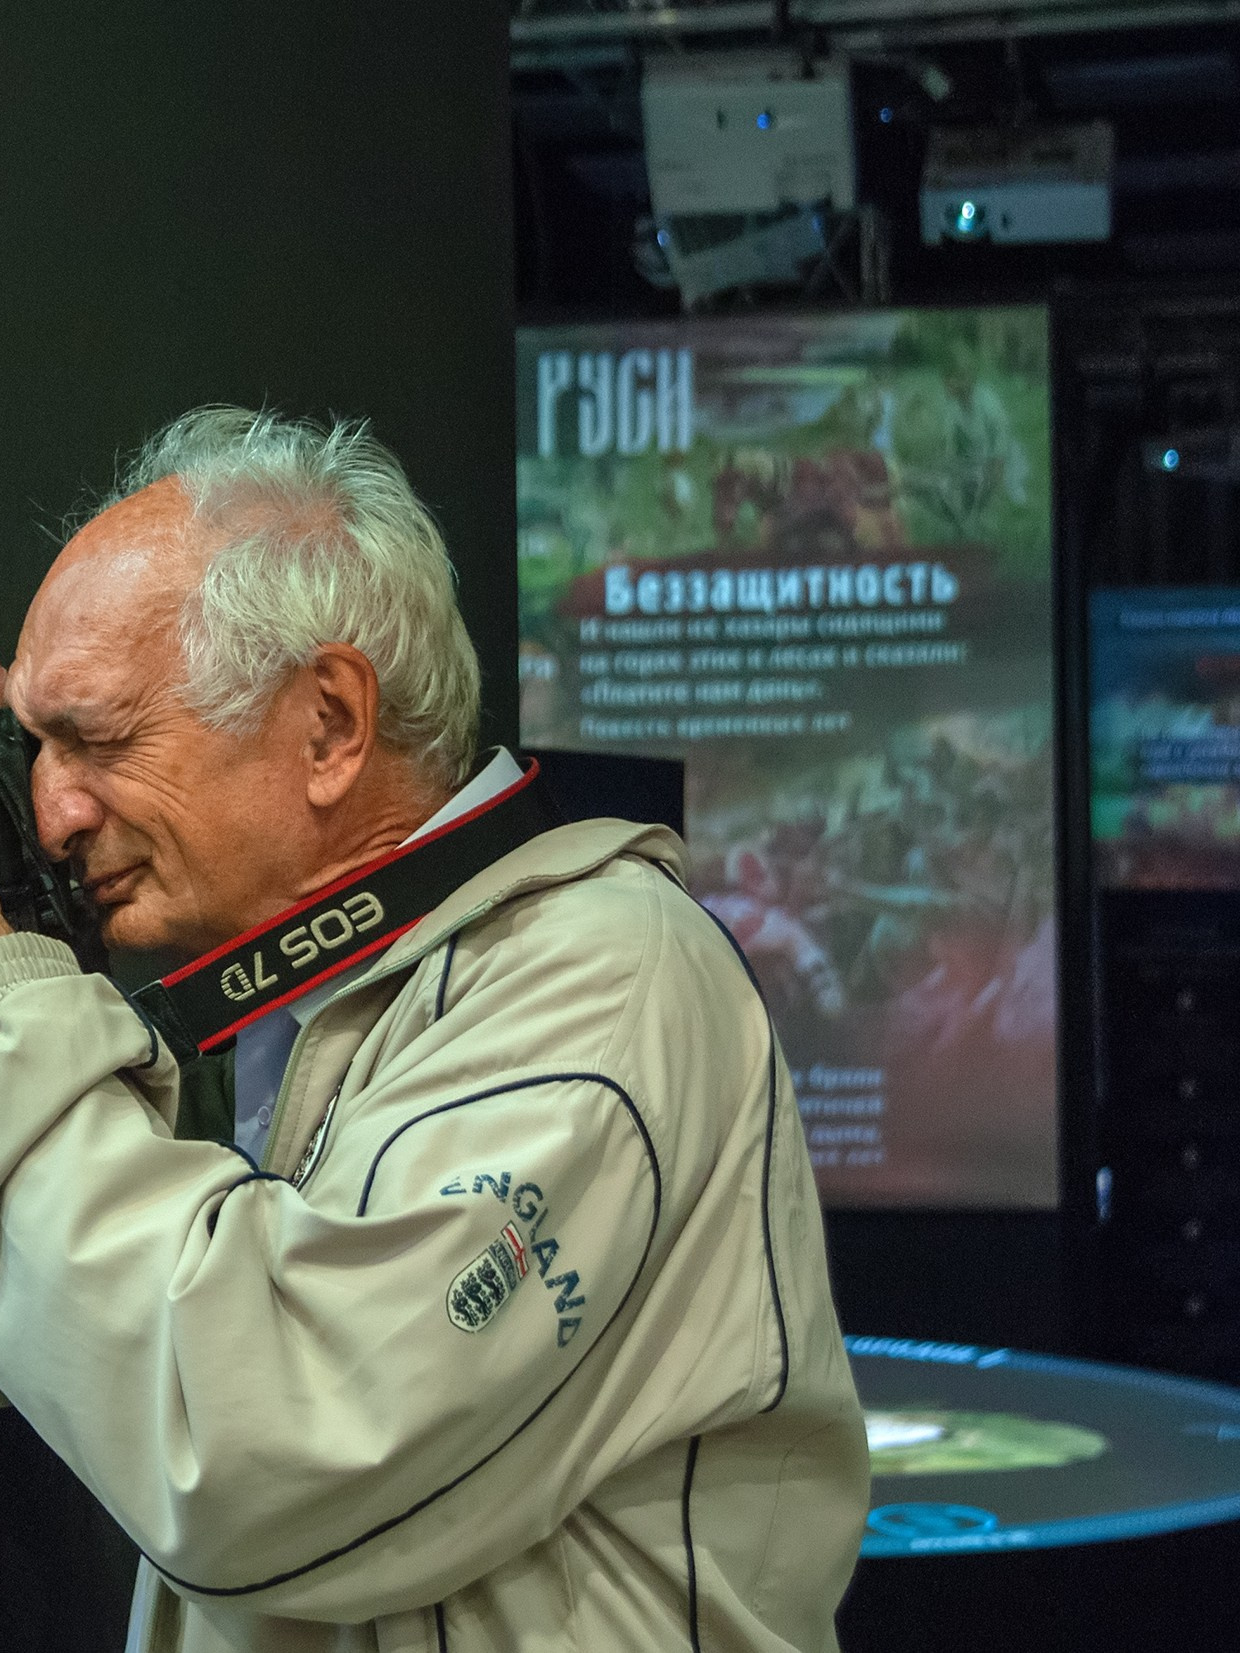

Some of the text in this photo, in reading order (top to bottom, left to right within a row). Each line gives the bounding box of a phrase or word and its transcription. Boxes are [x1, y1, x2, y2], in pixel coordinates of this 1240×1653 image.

[605, 562, 960, 616] Беззащитность
[220, 891, 385, 1002] EOS 7D
